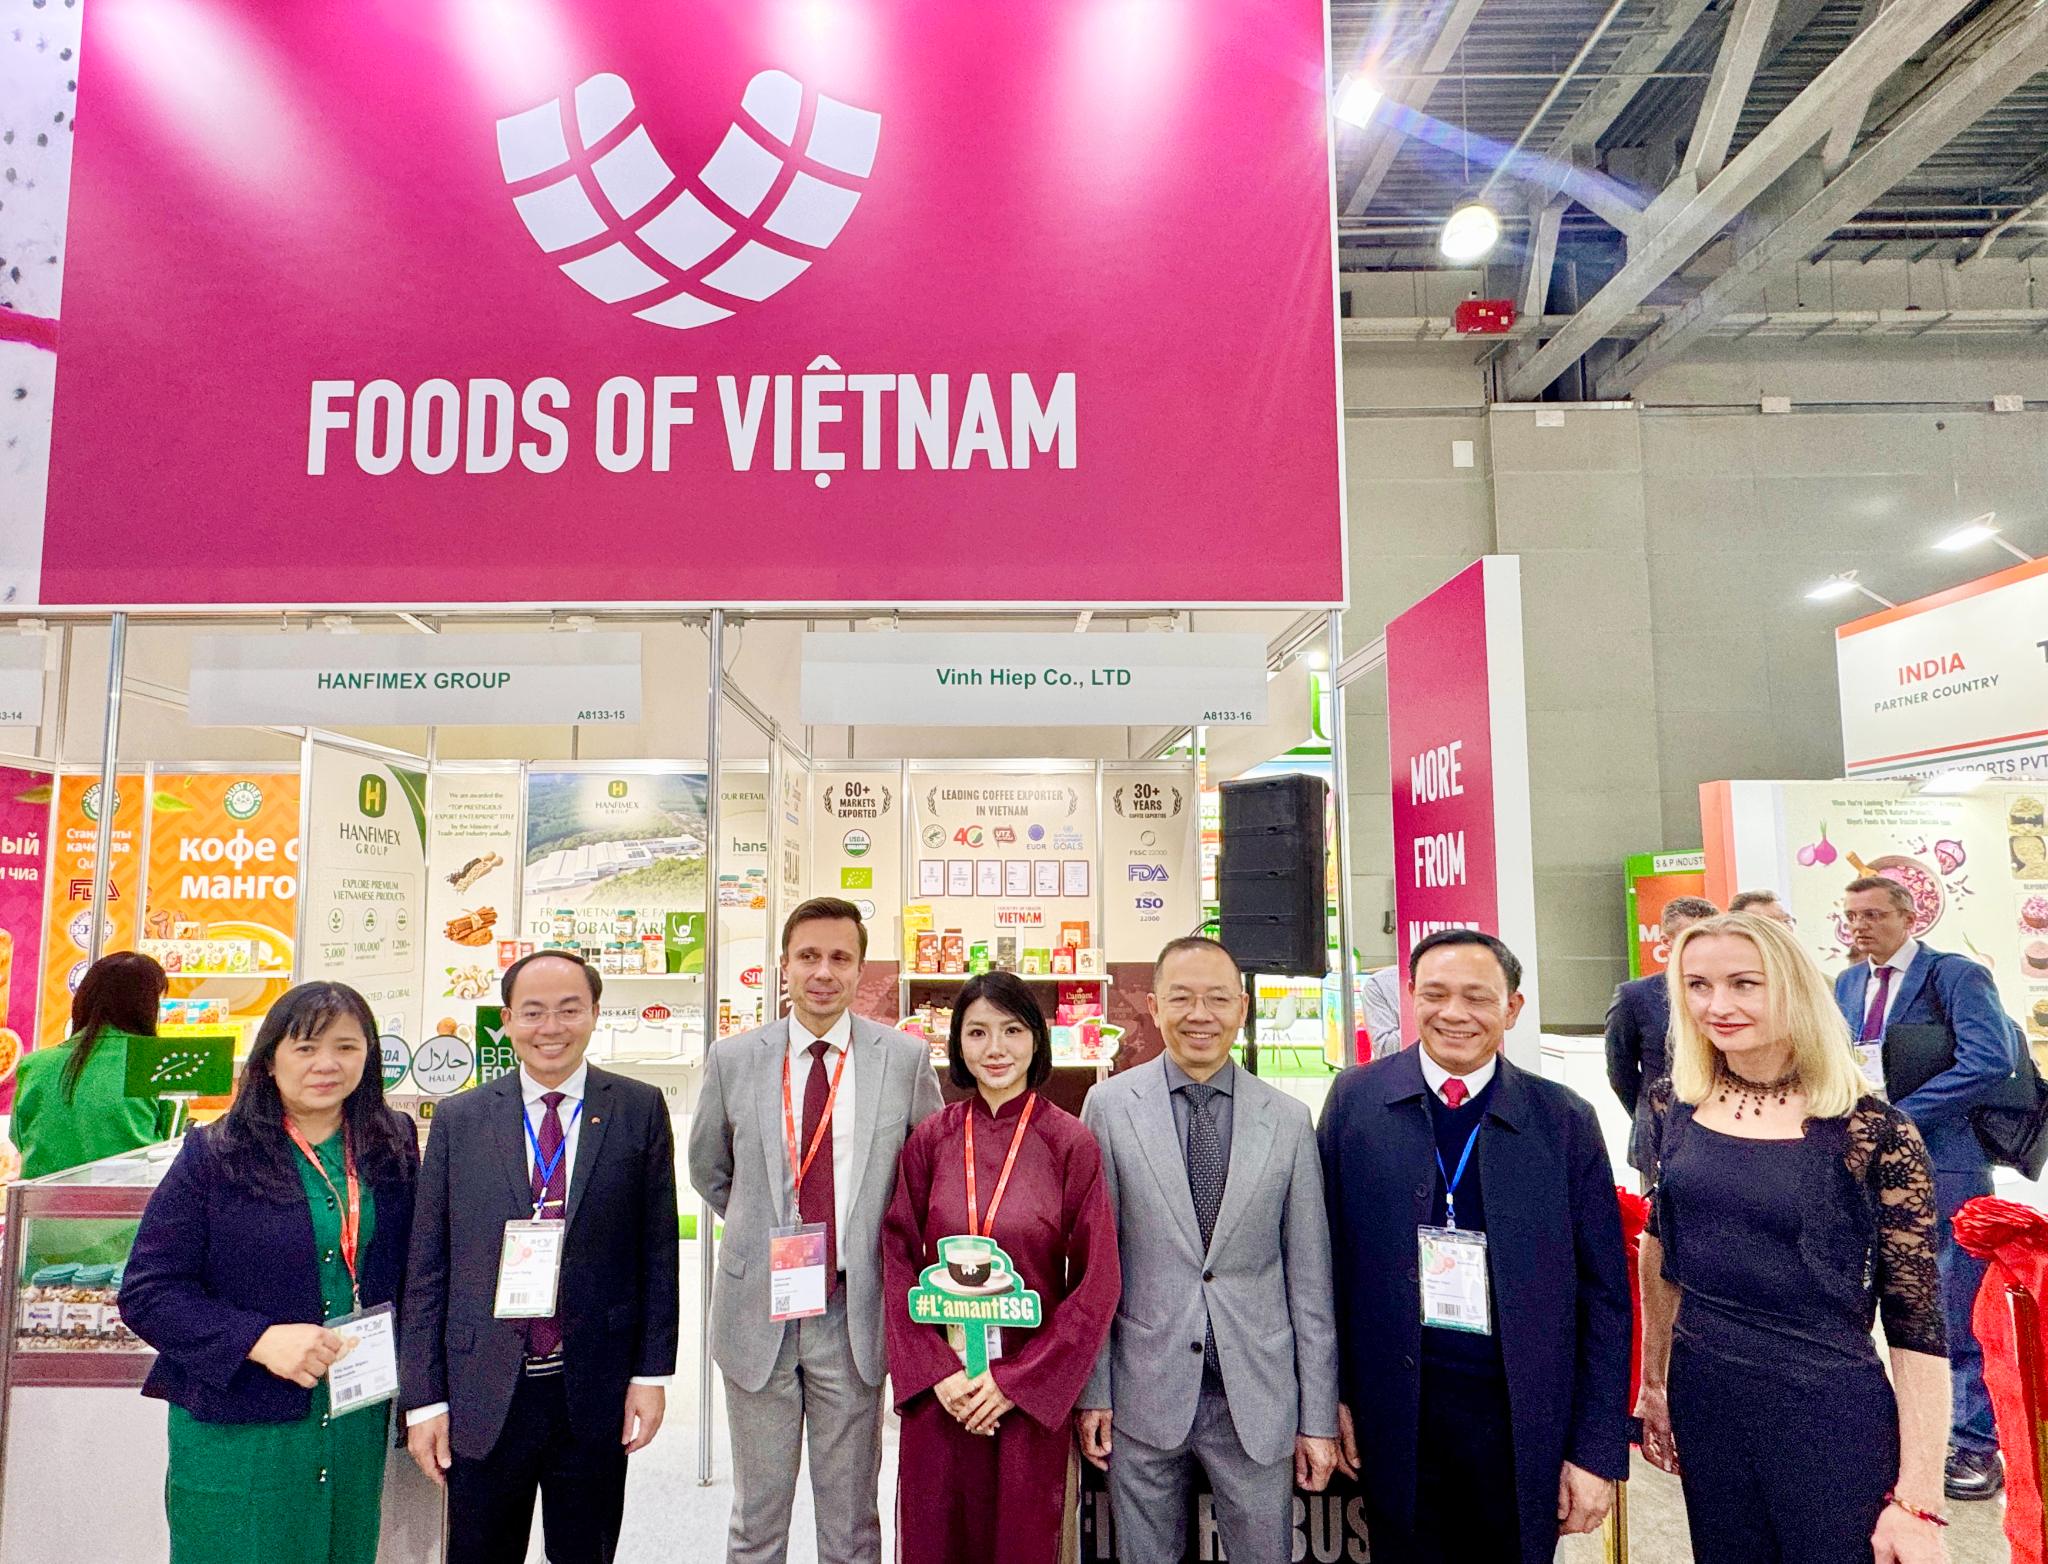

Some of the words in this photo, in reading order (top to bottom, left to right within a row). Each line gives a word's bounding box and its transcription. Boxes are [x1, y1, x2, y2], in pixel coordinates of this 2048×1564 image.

[307, 376, 570, 476] FOODS
[595, 375, 698, 473] OF
[717, 355, 1077, 489] VIỆTNAM
[1898, 652, 1966, 686] INDIA
[317, 672, 428, 690] HANFIMEX
[433, 672, 511, 690] GROUP
[936, 667, 983, 686] Vinh
[990, 667, 1037, 690] Hiep
[1043, 668, 1084, 689] Co.,
[1091, 669, 1132, 686] LTD
[1874, 690, 1929, 713] PARTNER
[1932, 674, 2000, 700] COUNTRY
[577, 710, 626, 720] A8133-15
[1203, 711, 1253, 721] A8133-16
[1410, 740, 1464, 806] MORE
[720, 792, 738, 800] OUR
[844, 781, 871, 798] 60+
[941, 789, 981, 801] LEADING
[982, 789, 1014, 801] COFFEE
[1017, 789, 1064, 801] EXPORTER
[1133, 783, 1161, 800] 30+
[595, 800, 639, 809] HANFIMEX
[839, 798, 876, 808] MARKETS
[1132, 800, 1163, 811] YEARS
[837, 808, 877, 818] EXPORTED
[975, 805, 987, 816] IN
[989, 805, 1029, 816] VIETNAM
[339, 822, 401, 846] HANFIMEX
[179, 828, 276, 870] кофе
[355, 843, 389, 856] GROUP
[1053, 842, 1084, 850] GOALS
[1413, 830, 1467, 889] FROM
[8, 866, 38, 880] чиа
[1128, 864, 1169, 881] FDA
[180, 874, 297, 900] манго
[342, 878, 370, 889] EXPLORE
[371, 879, 399, 890] PREMIUM
[333, 890, 375, 901] VIETNAMESE
[375, 891, 406, 902] PRODUCTS
[1135, 897, 1164, 909] ISO
[575, 907, 648, 918] VIETNASE
[998, 911, 1042, 923] VIETNAM
[530, 921, 550, 935] TO
[324, 947, 346, 960] 5,000
[417, 1047, 469, 1072] حلال
[428, 1073, 457, 1083] HALAL
[915, 1294, 1035, 1321] #L'amantESG
